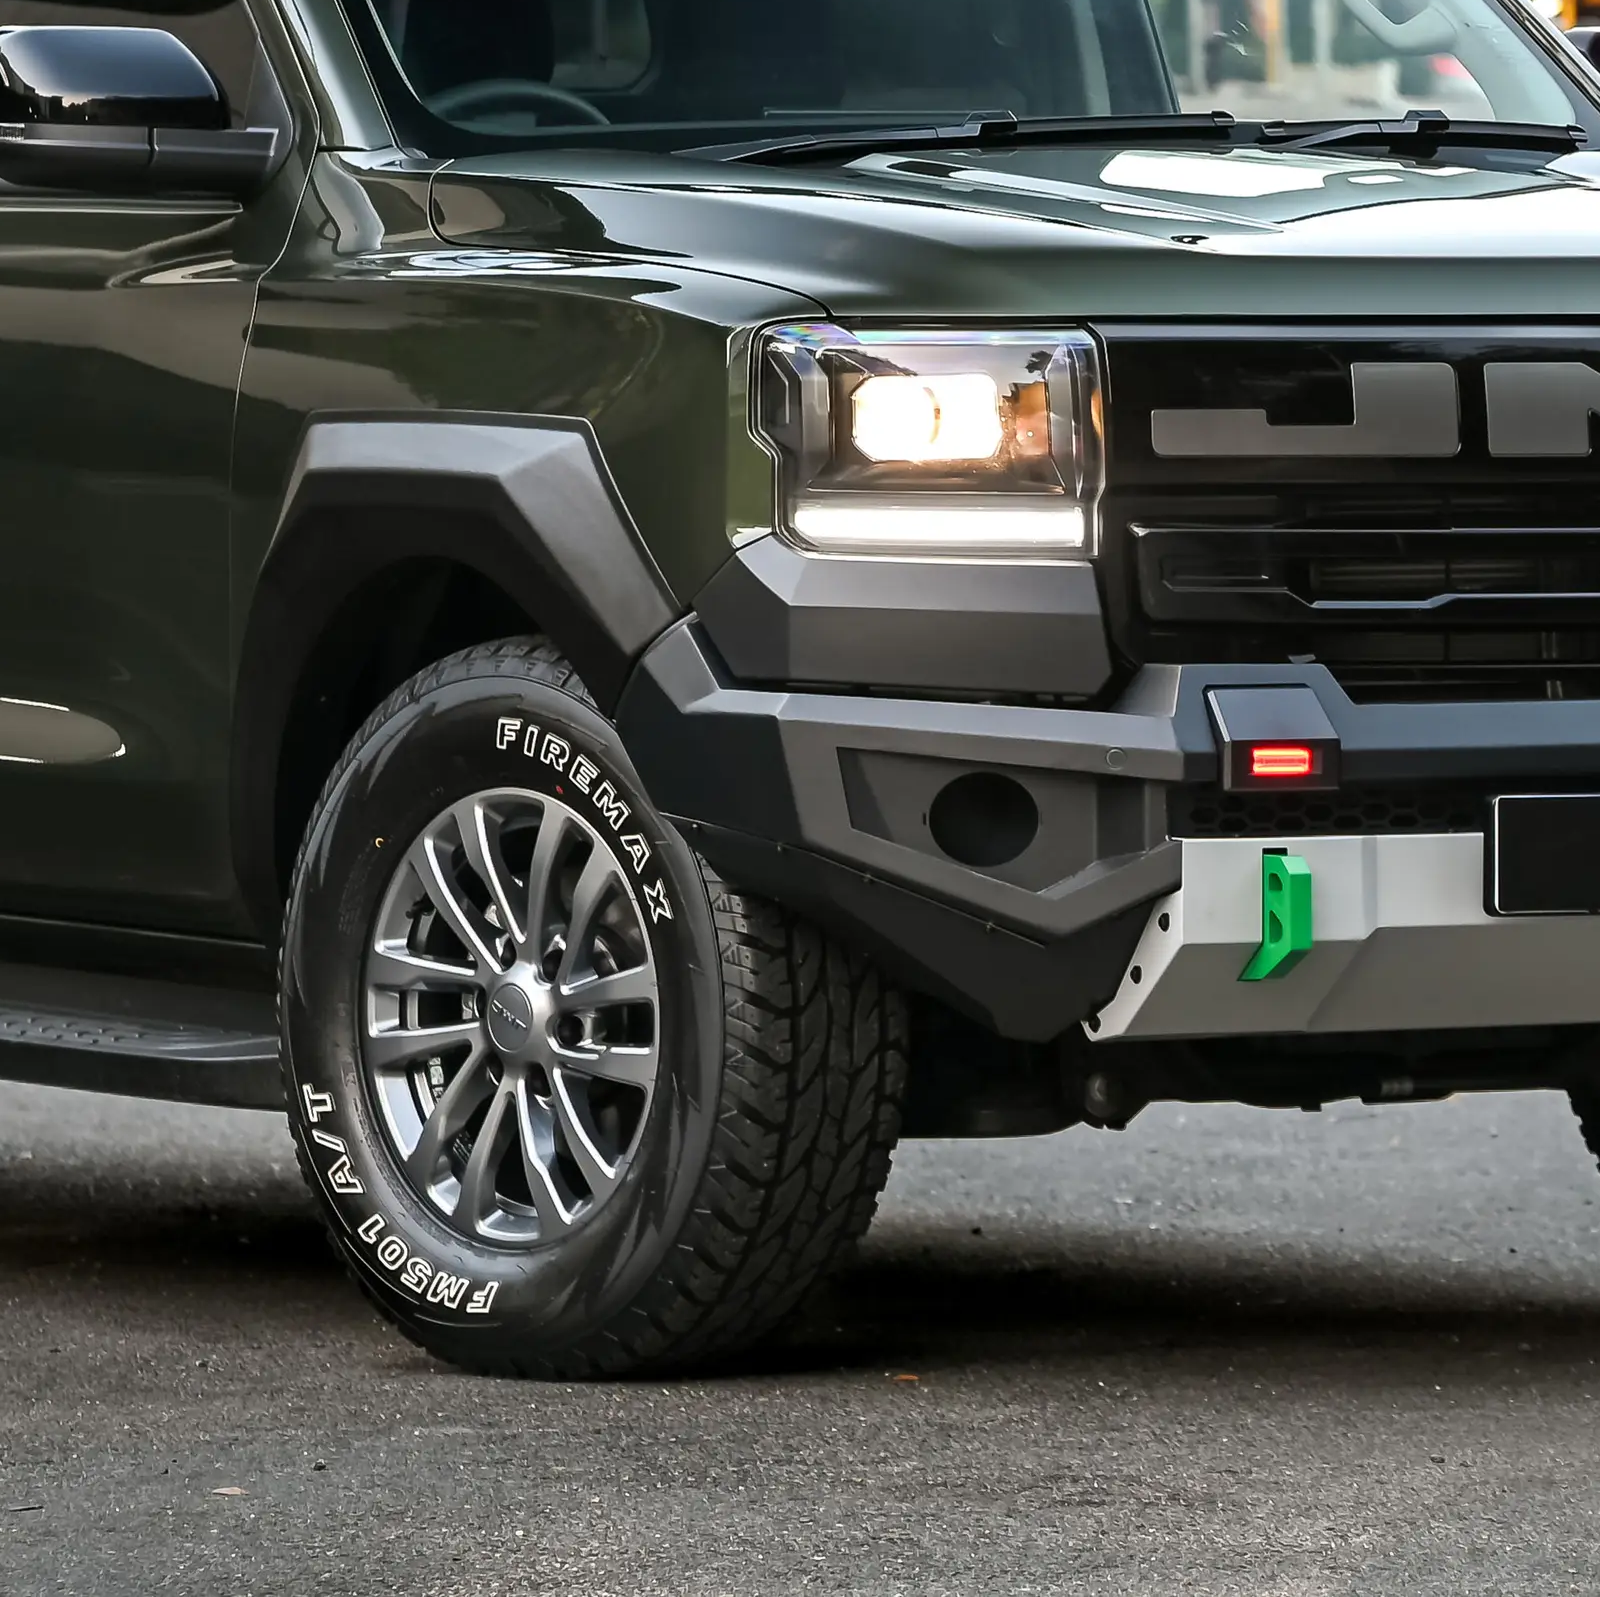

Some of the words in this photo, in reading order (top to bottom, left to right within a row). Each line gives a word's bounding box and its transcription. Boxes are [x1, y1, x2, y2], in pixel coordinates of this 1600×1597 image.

[496, 717, 675, 925] FIREMAX
[302, 1083, 367, 1194] A/T
[357, 1213, 500, 1315] FM501
